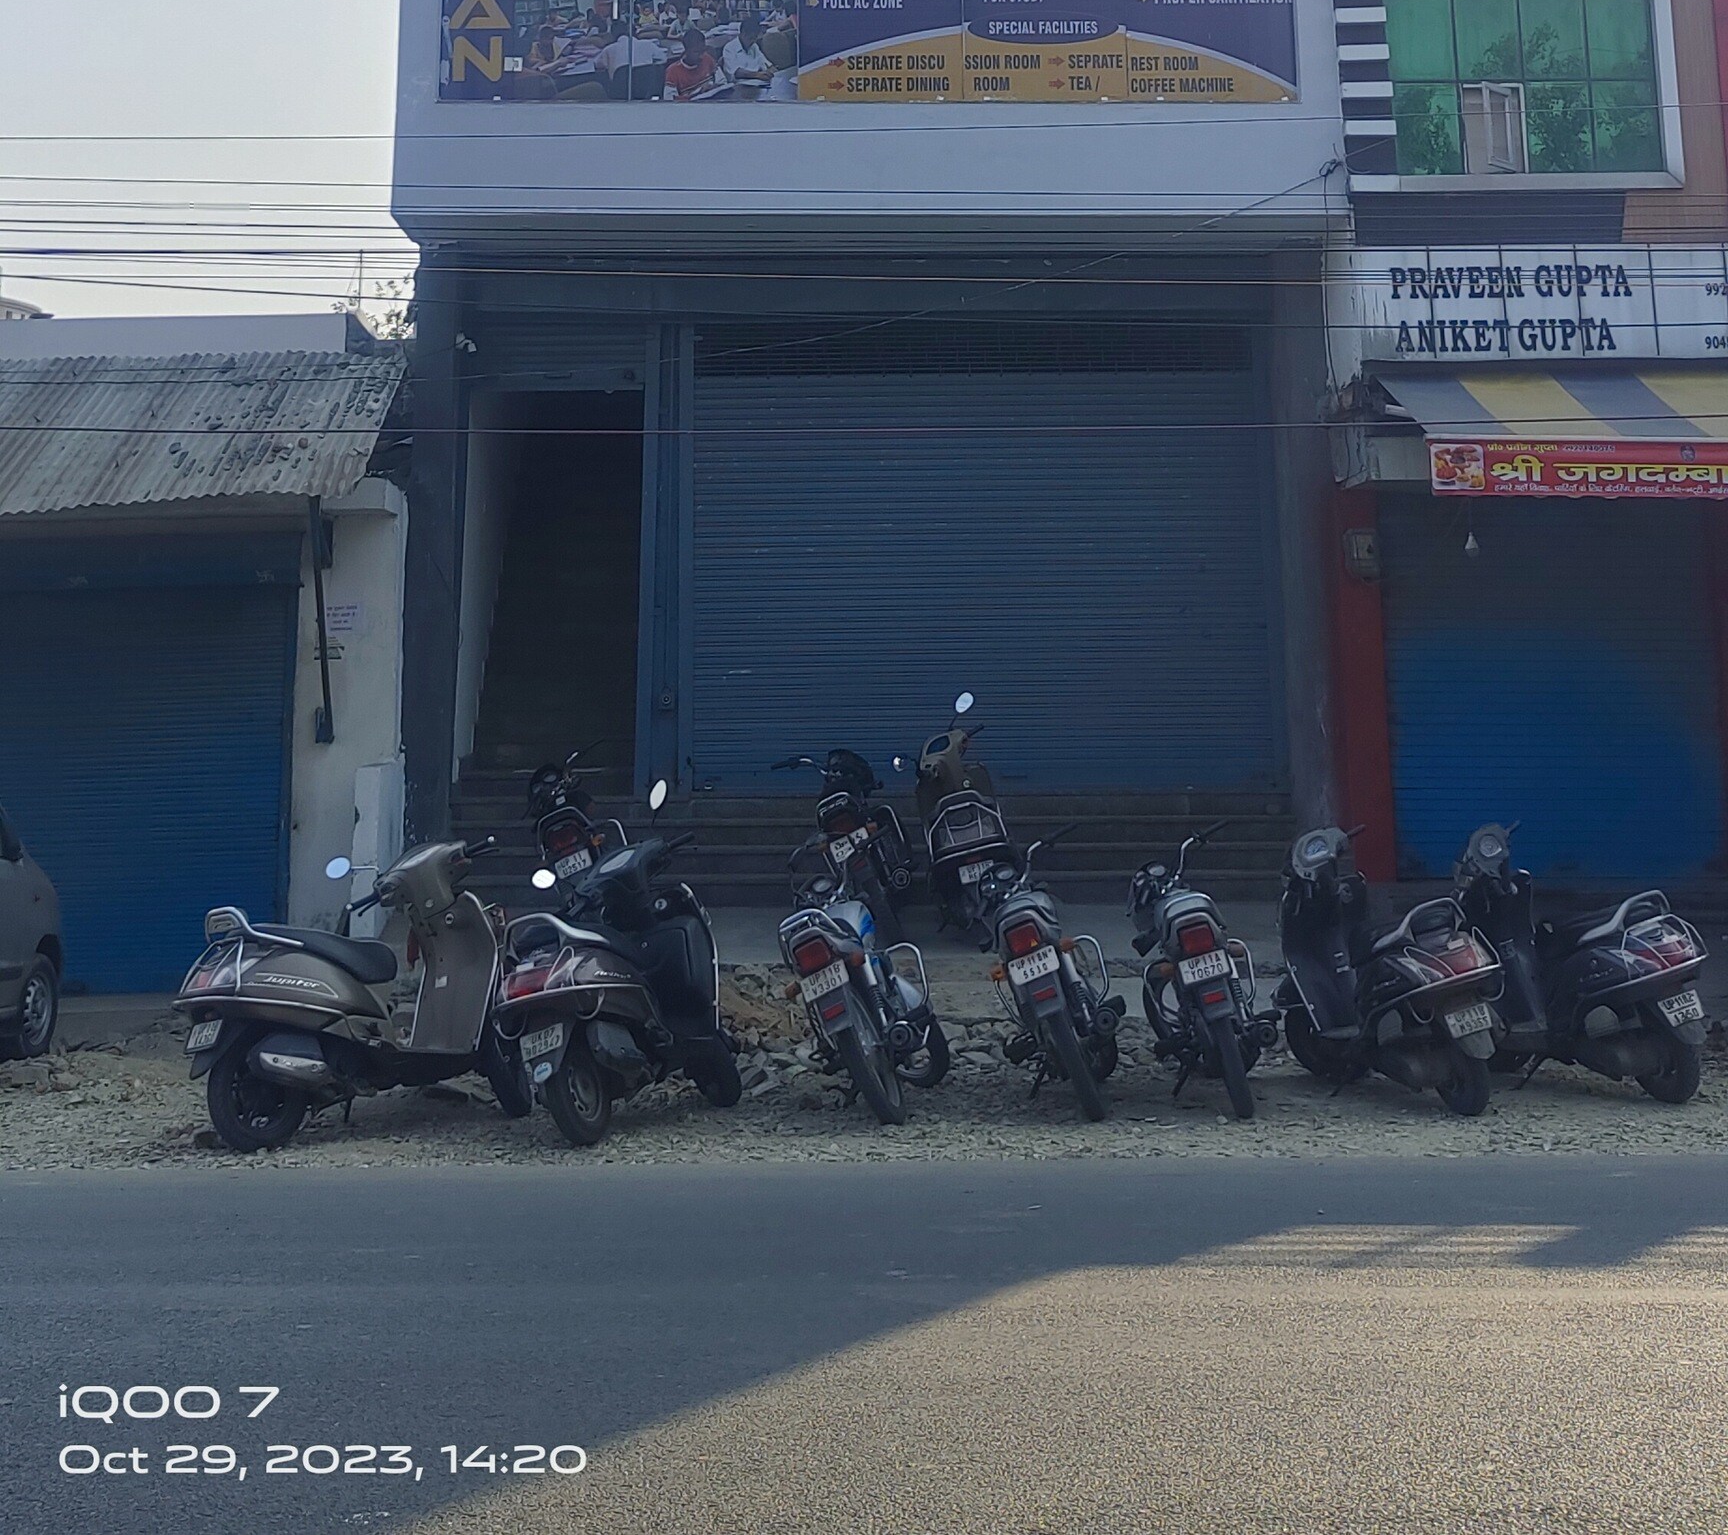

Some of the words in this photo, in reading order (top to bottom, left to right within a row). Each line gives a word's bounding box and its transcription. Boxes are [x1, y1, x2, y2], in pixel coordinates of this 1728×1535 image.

[988, 21, 1036, 35] SPECIAL
[1039, 21, 1098, 34] FACILITIES
[847, 55, 902, 70] SEPRATE
[907, 55, 945, 70] DISCU
[964, 55, 1000, 70] SSION
[1004, 54, 1041, 69] ROOM
[1068, 54, 1123, 69] SEPRATE
[1131, 56, 1160, 71] REST
[1164, 56, 1199, 71] ROOM
[847, 77, 902, 92] SEPRATE
[907, 77, 950, 92] DINING
[974, 76, 1010, 91] ROOM
[1068, 76, 1092, 91] TEA
[1094, 76, 1101, 92] /
[1131, 78, 1175, 93] COFFEE
[1180, 77, 1234, 92] MACHINE
[1390, 266, 1525, 299] PRAVEEN
[1534, 264, 1633, 298] GUPTA
[1395, 319, 1510, 353] ANIKET
[1518, 318, 1617, 352] GUPTA
[1705, 335, 1728, 349] 904
[1490, 455, 1545, 482] श्री
[1190, 963, 1224, 980] Y0670
[263, 976, 320, 987] Jupiter
[811, 974, 842, 996] V3301
